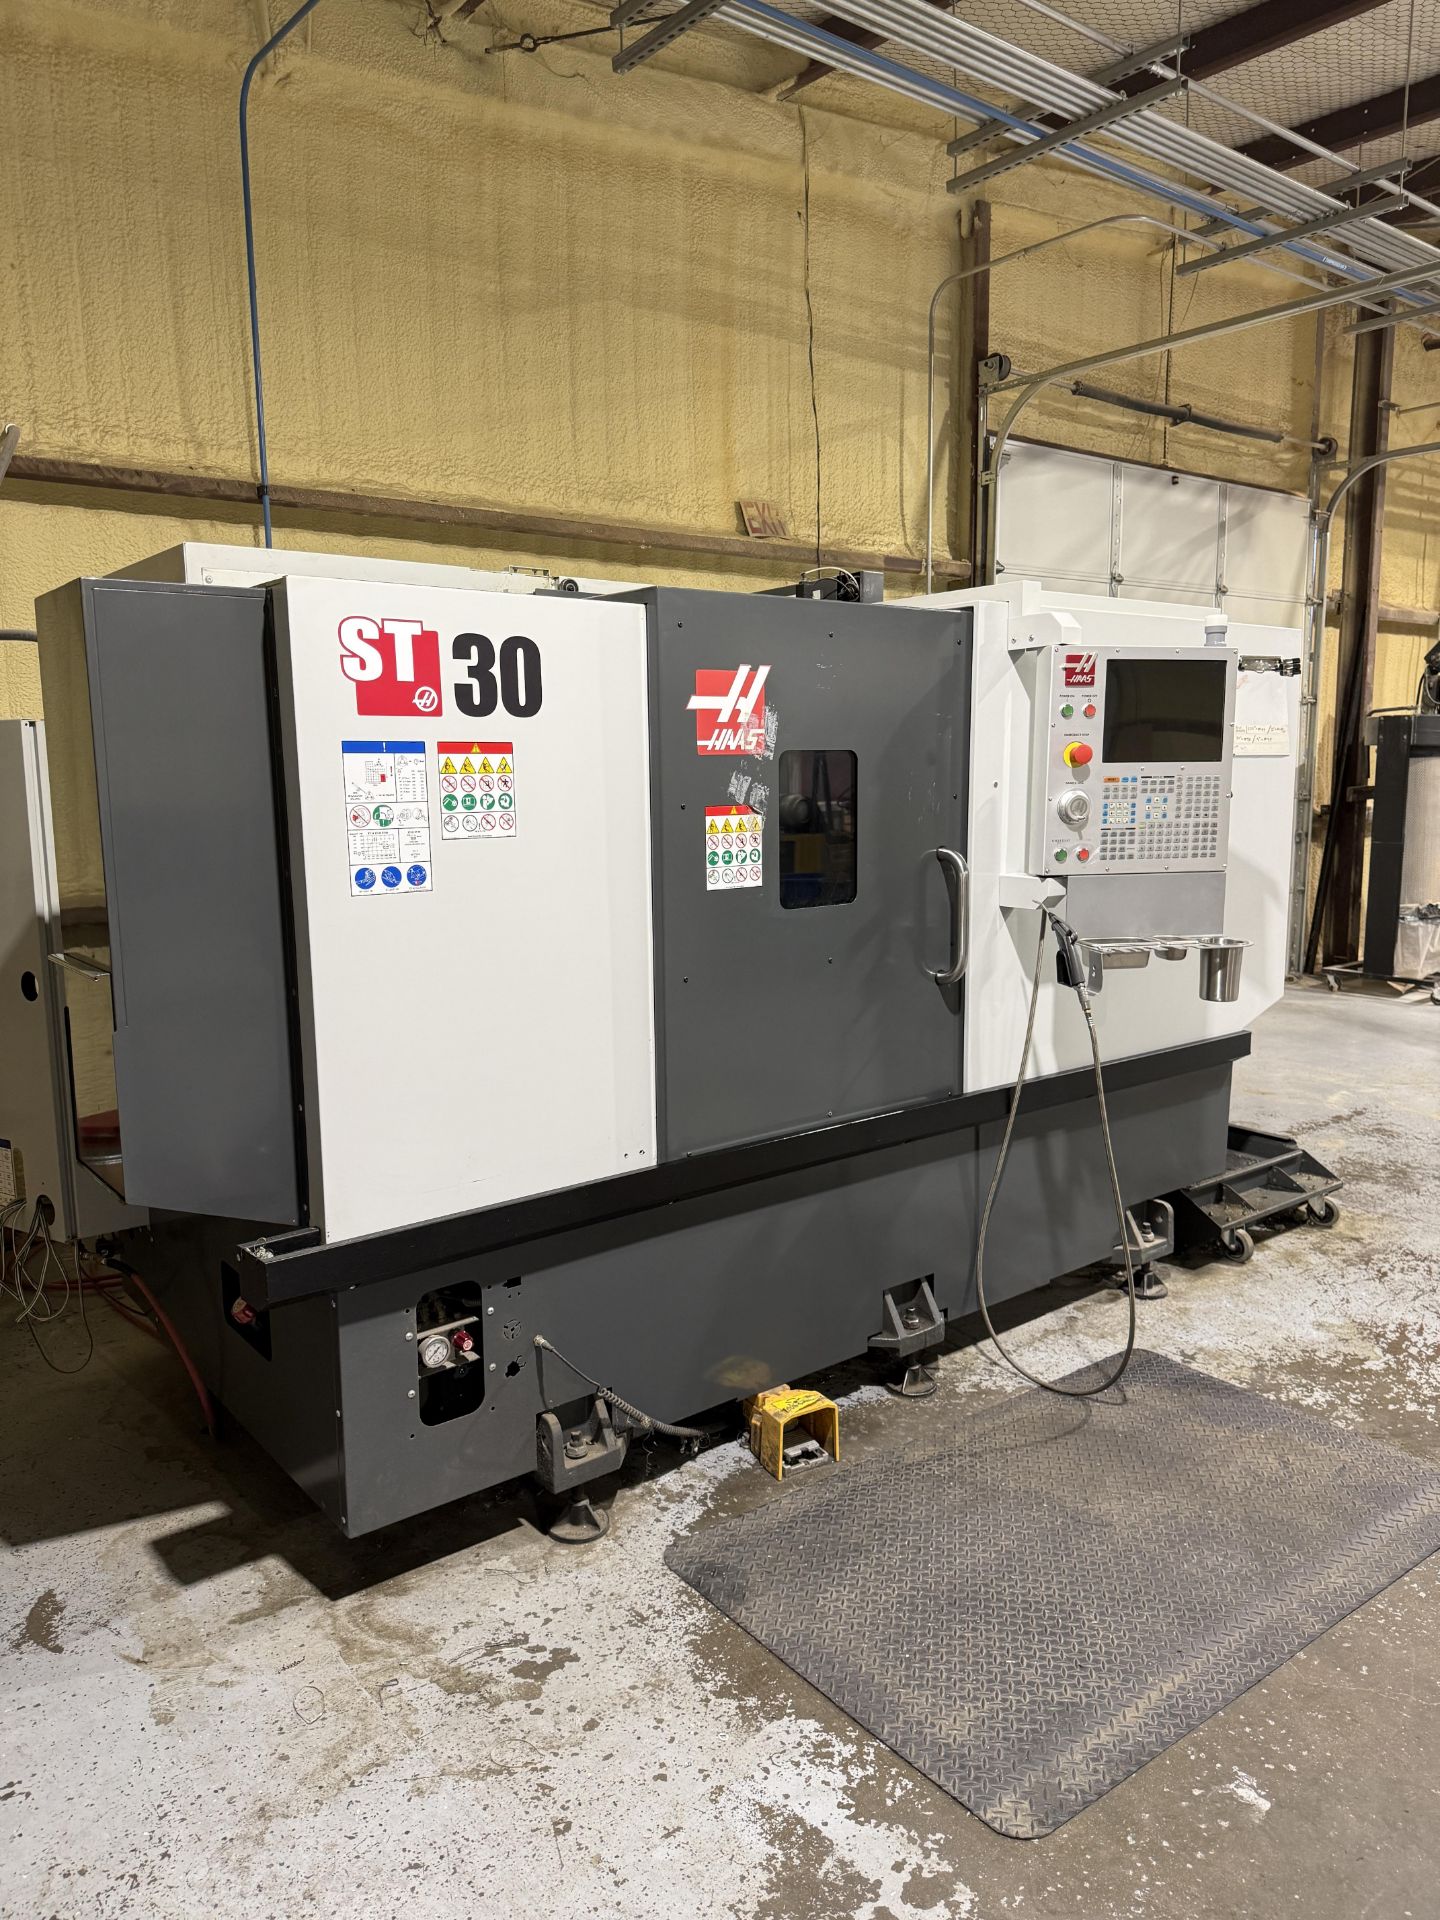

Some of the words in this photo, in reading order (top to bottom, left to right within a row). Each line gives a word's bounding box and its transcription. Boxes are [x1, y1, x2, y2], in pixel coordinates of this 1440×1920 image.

[338, 616, 423, 682] ST
[452, 632, 543, 718] 30
[1066, 674, 1095, 684] HAAS
[697, 728, 766, 751] HAAS
